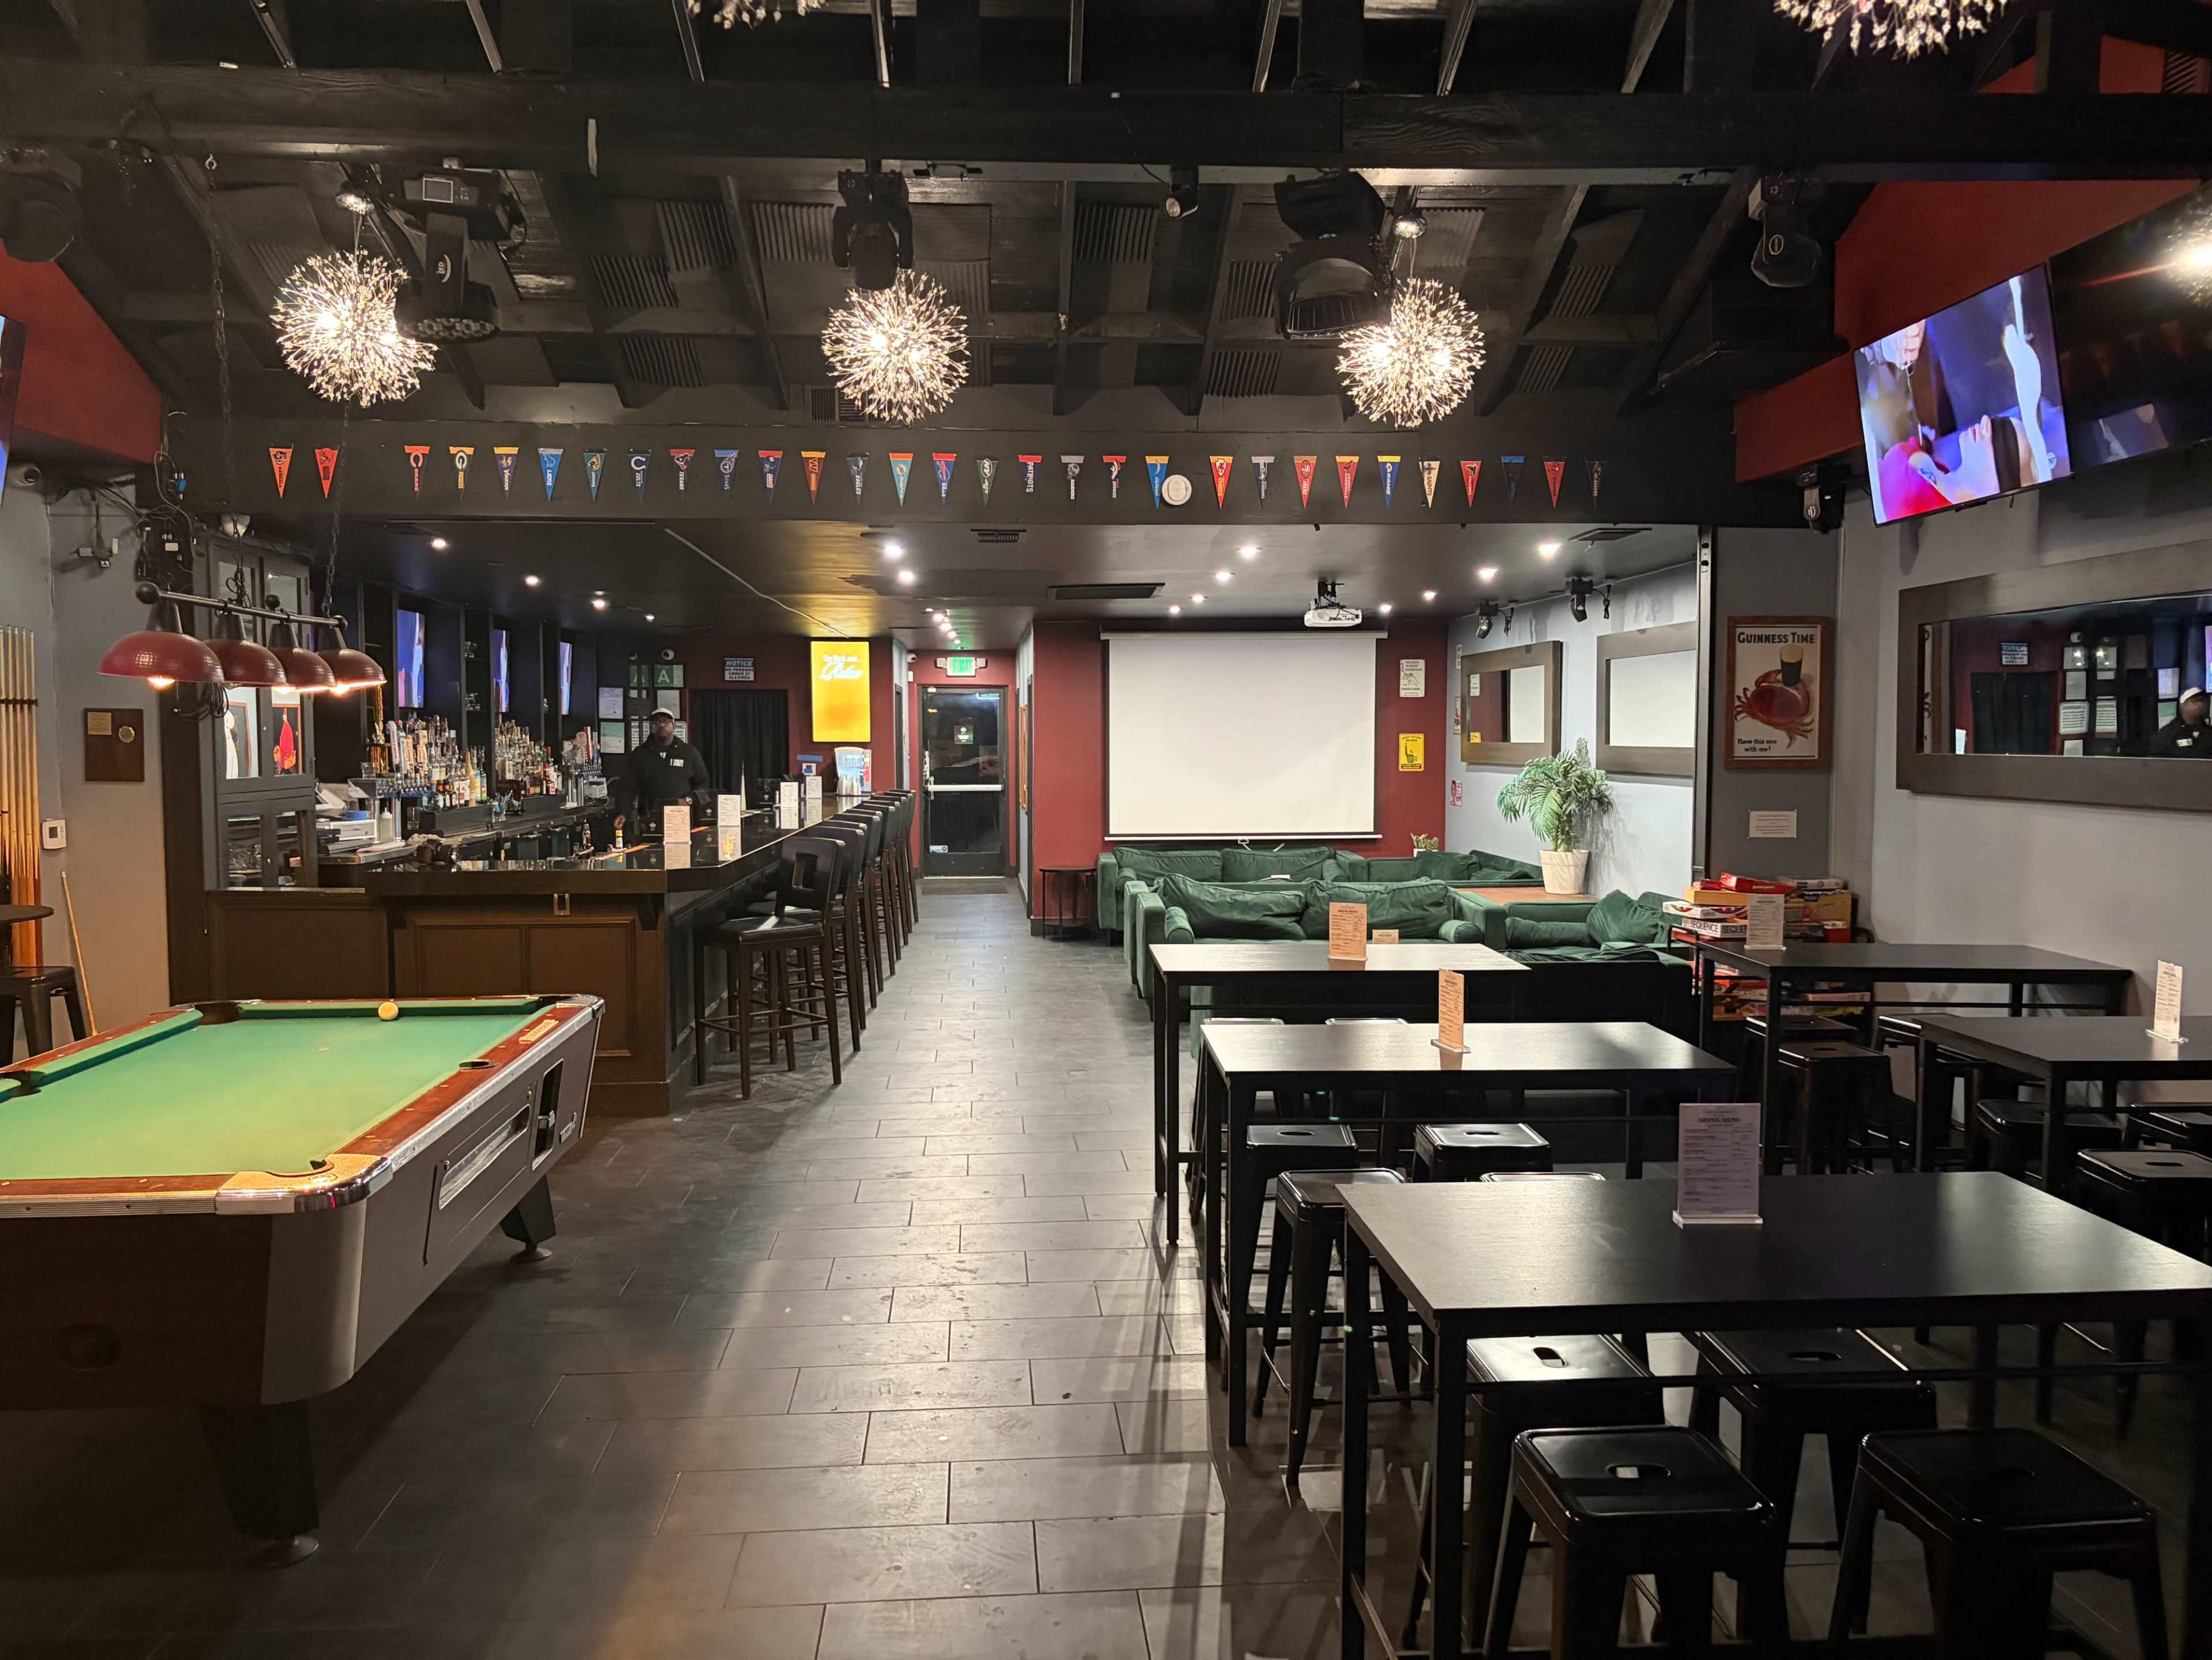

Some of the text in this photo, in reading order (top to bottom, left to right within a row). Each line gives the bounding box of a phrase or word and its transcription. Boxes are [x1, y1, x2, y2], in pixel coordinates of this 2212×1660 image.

[1026, 462, 1034, 492] PATRIOTS
[1737, 632, 1815, 644] GUINNESS TIME
[657, 670, 671, 683] A
[1690, 920, 1719, 933] SEQUENCE
